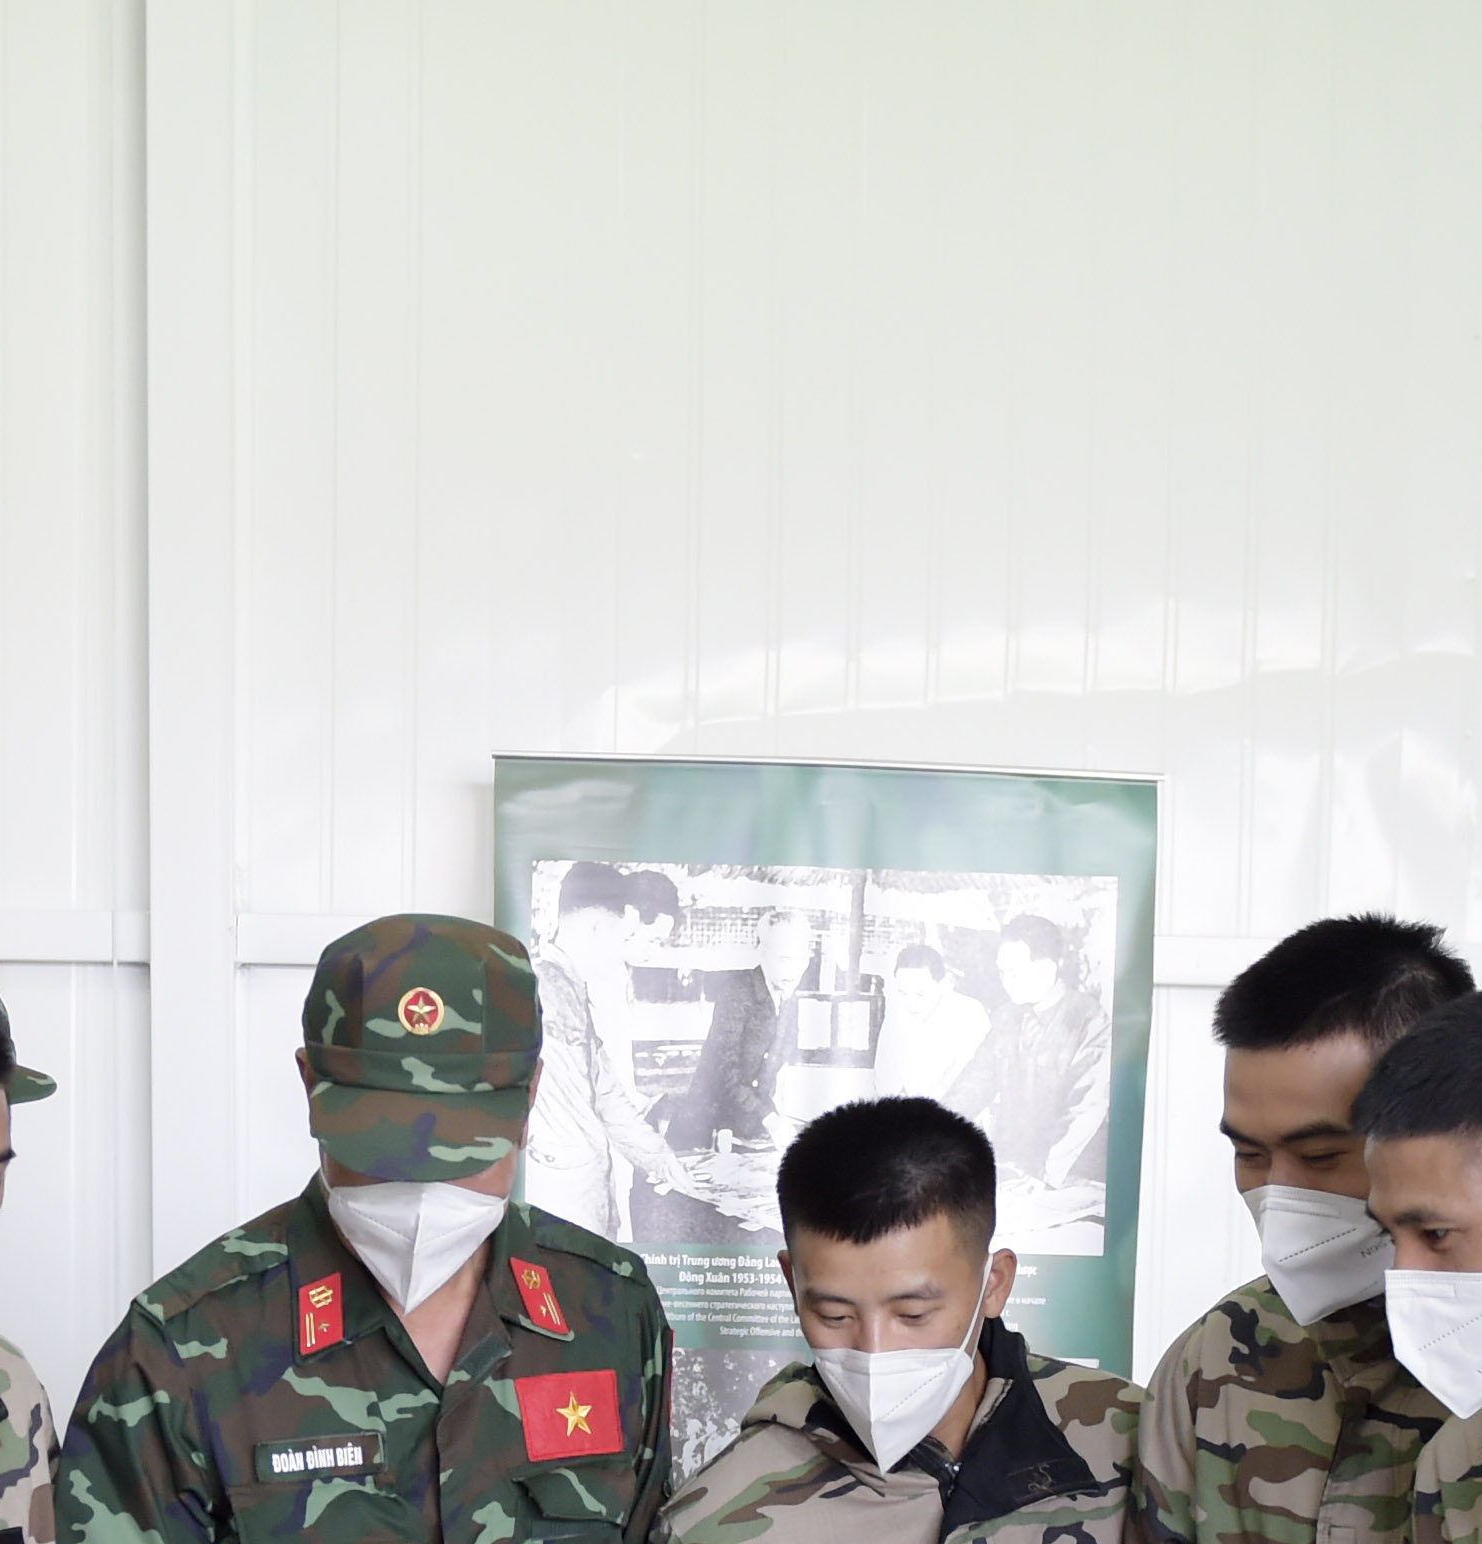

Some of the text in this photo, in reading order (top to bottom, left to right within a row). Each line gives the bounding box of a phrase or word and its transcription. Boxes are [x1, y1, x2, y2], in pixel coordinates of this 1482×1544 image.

[682, 1255, 710, 1267] Trung
[706, 1271, 730, 1284] Xuân
[732, 1273, 782, 1284] 1953-1954
[272, 1442, 364, 1473] ĐOÀN ĐÌNH BIÊN
